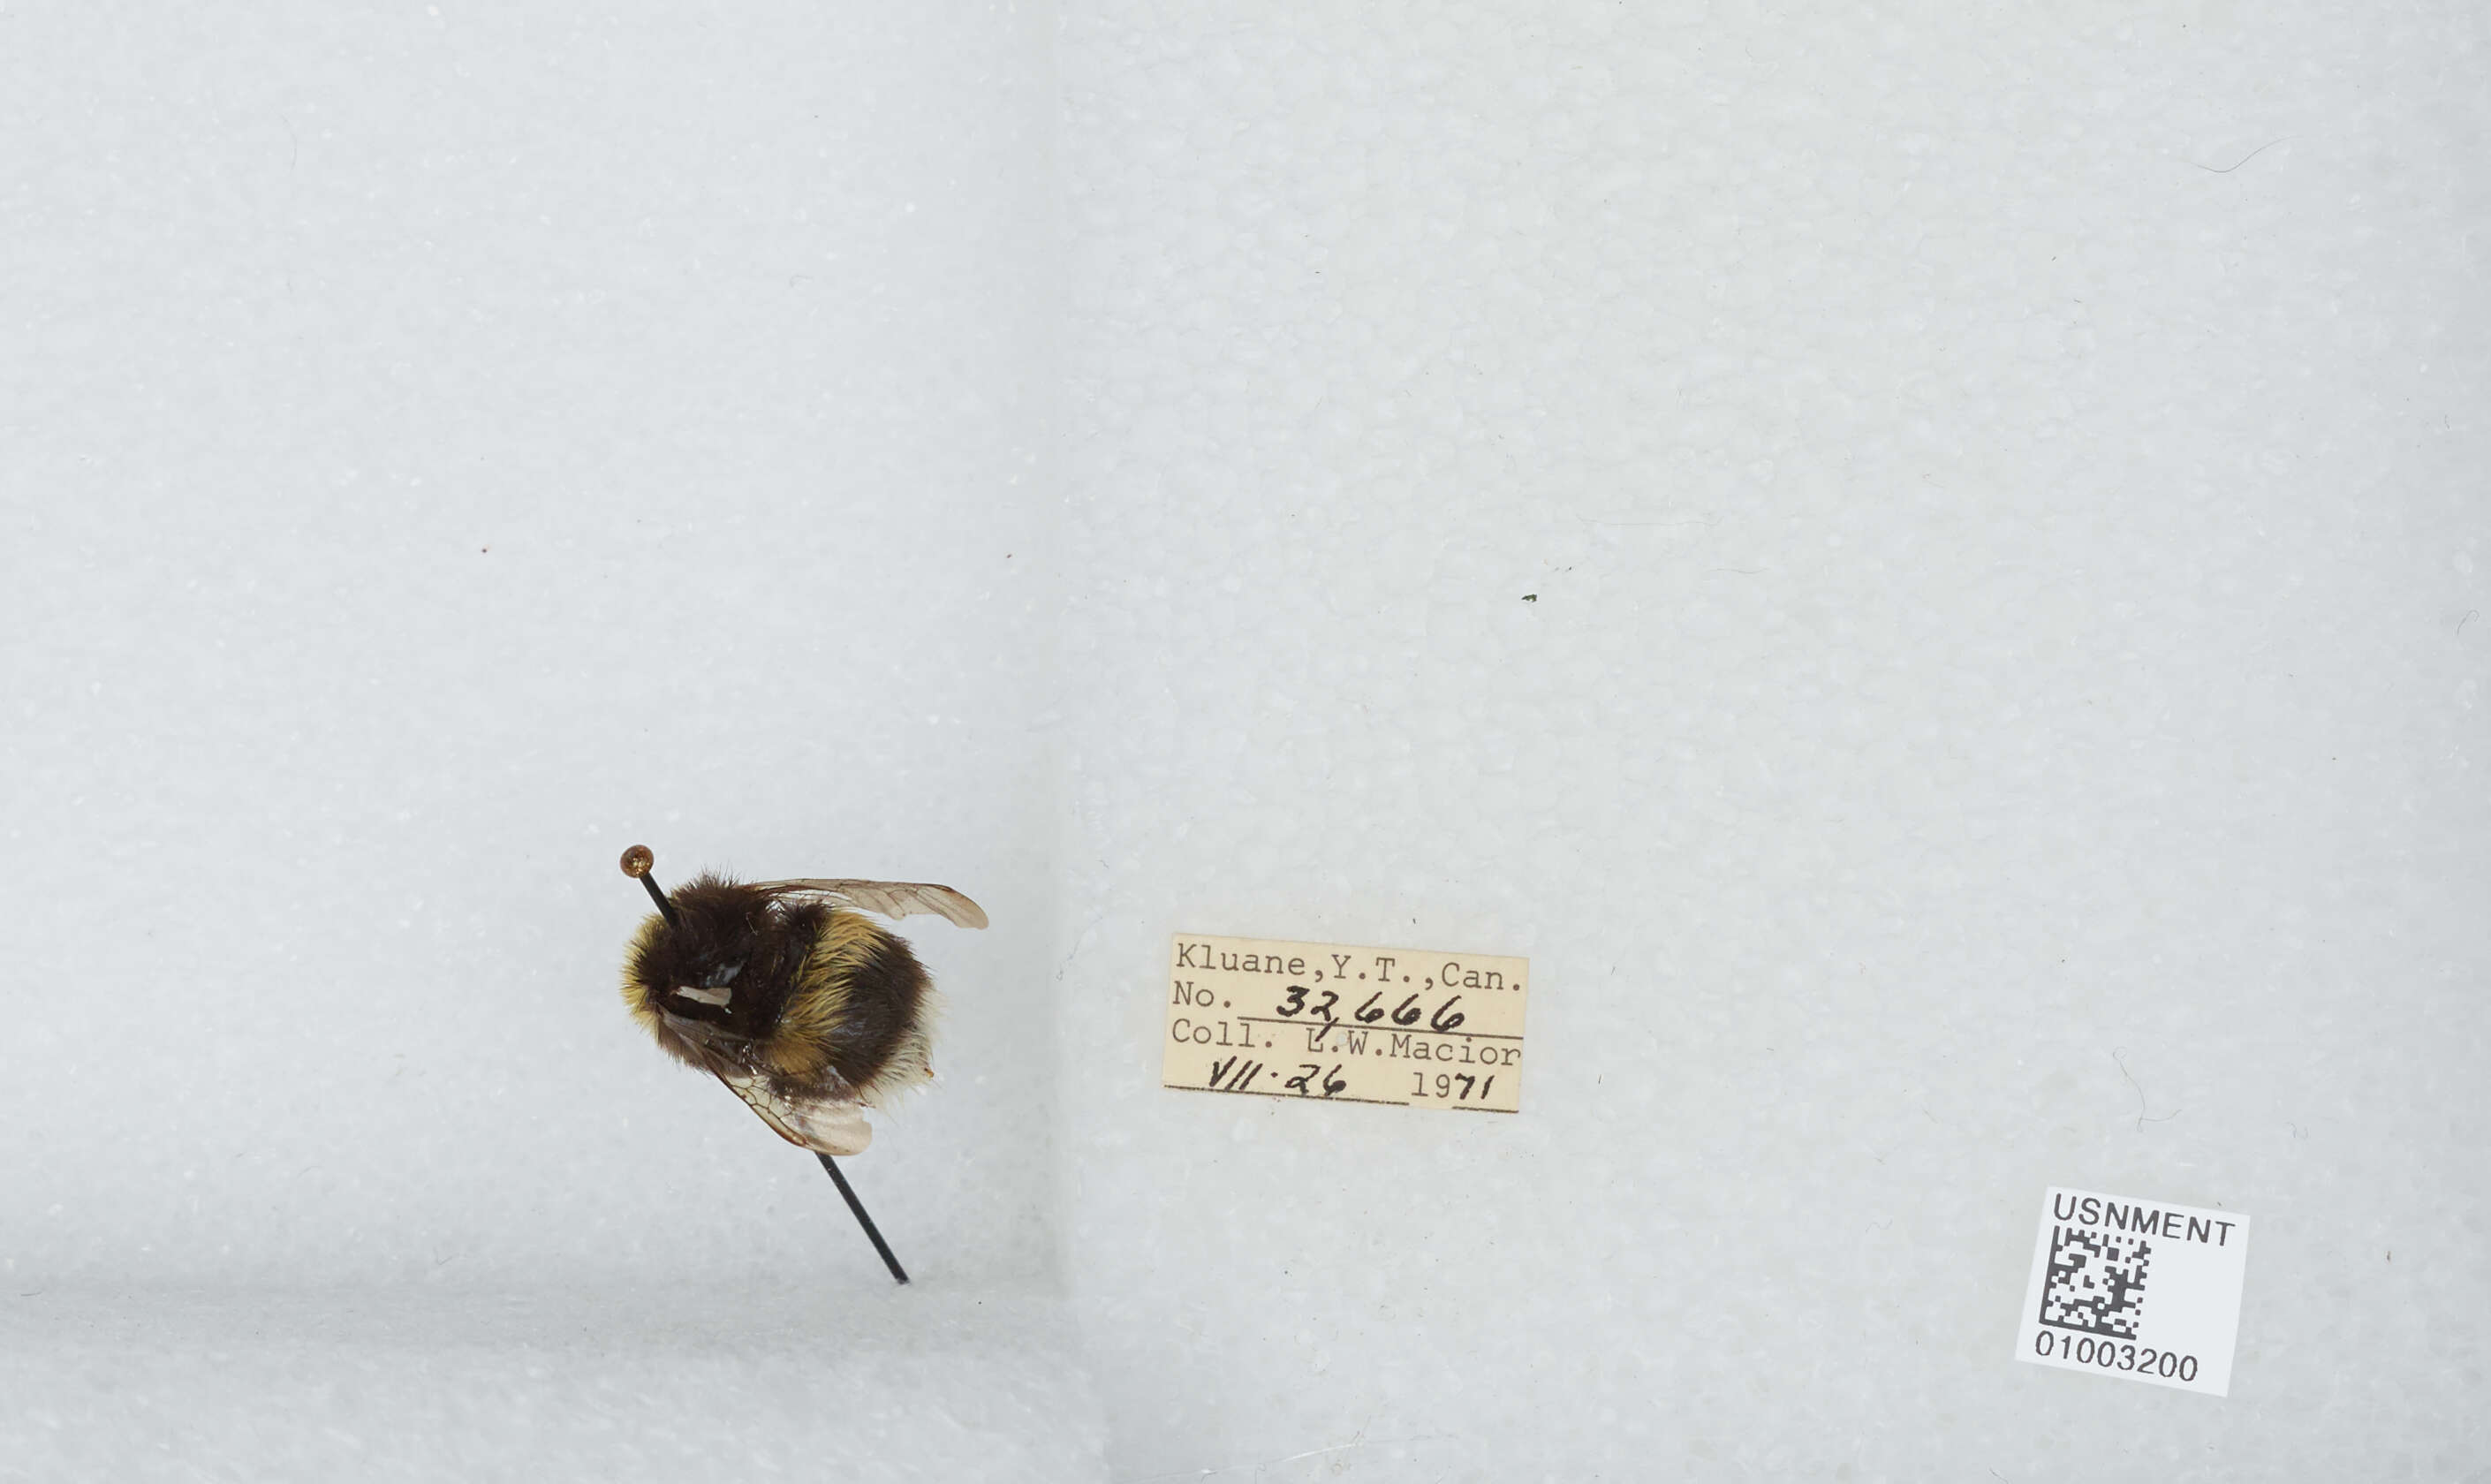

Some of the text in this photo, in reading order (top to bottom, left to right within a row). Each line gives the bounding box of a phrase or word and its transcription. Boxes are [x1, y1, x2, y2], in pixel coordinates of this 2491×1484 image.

[1172, 980, 1231, 1009] No.
[1172, 1018, 1273, 1049] Coll.
[1411, 1071, 1495, 1100] 1971
[2053, 1192, 2237, 1246] USNMENT
[2035, 1330, 2199, 1382] 01003200
